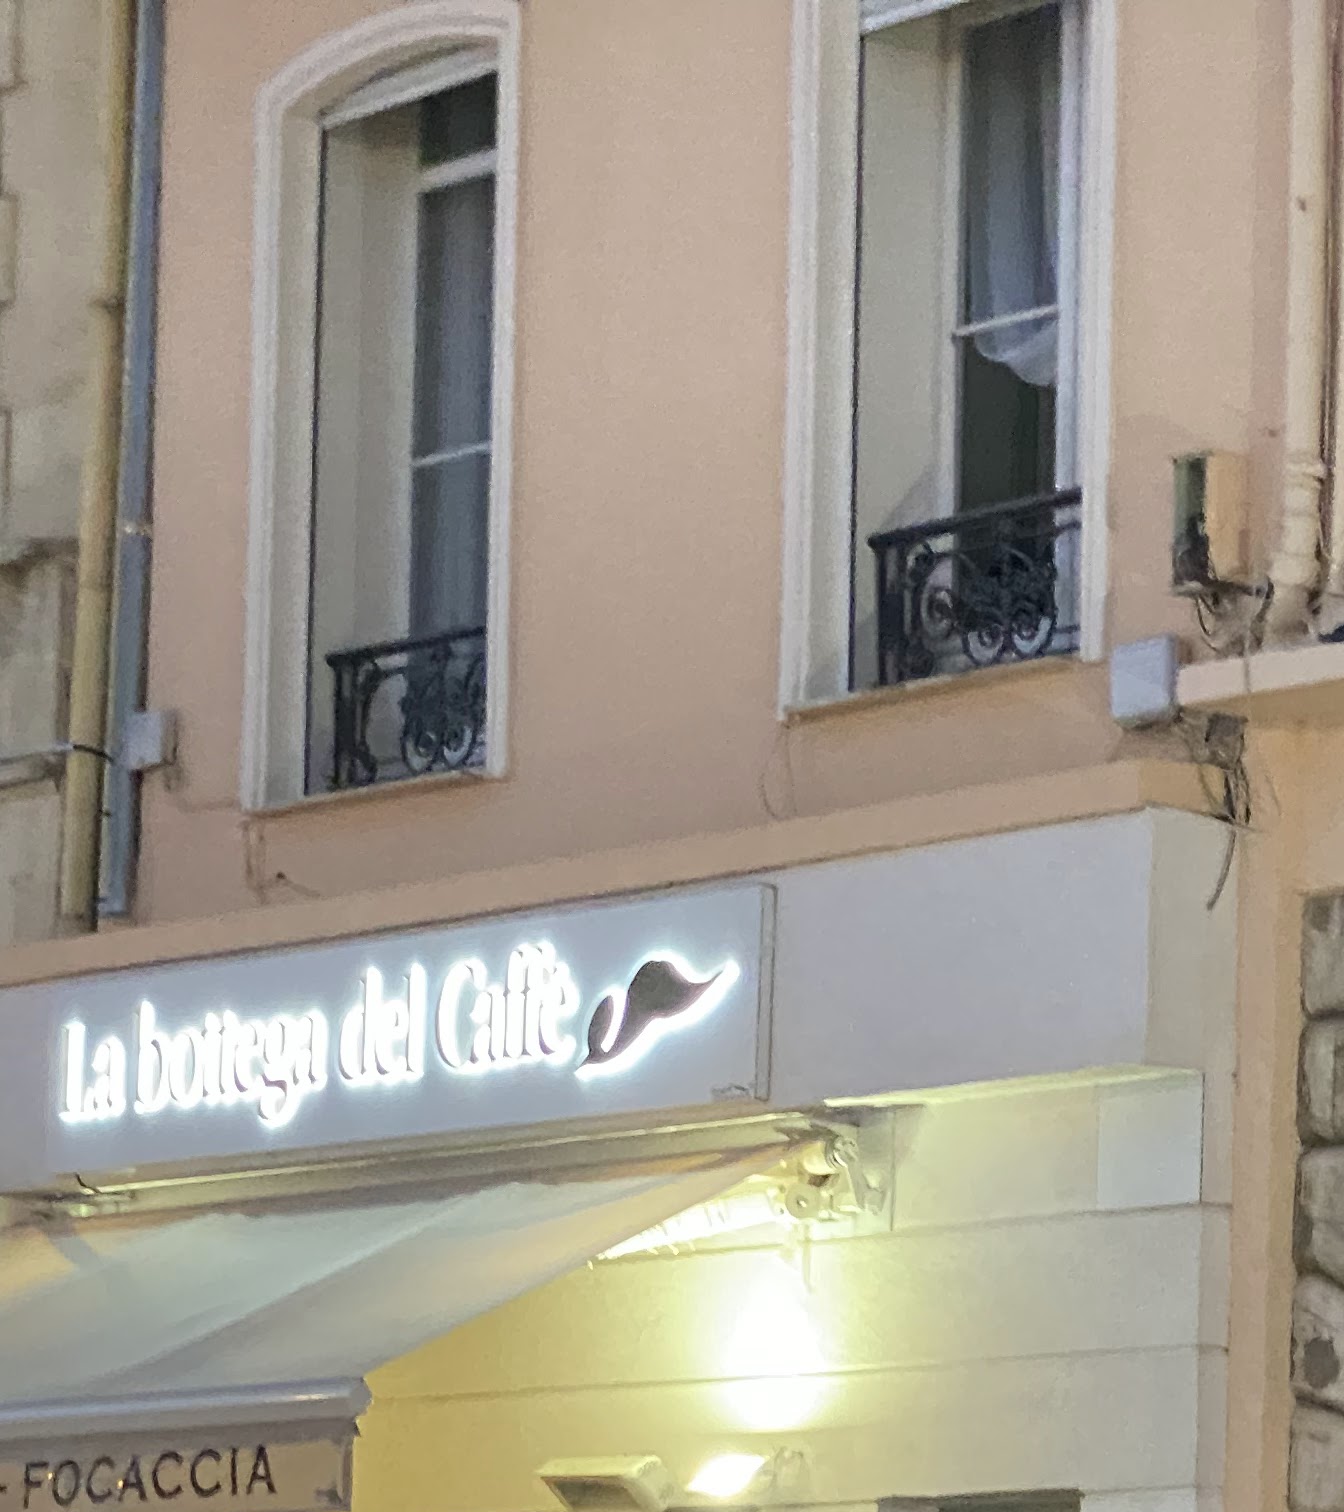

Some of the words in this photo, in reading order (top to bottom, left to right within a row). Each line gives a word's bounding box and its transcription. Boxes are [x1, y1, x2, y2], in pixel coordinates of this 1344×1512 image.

[58, 1017, 127, 1123] La
[133, 997, 328, 1130] bottega
[337, 960, 428, 1088] del
[23, 1443, 278, 1510] FOCACCIA
